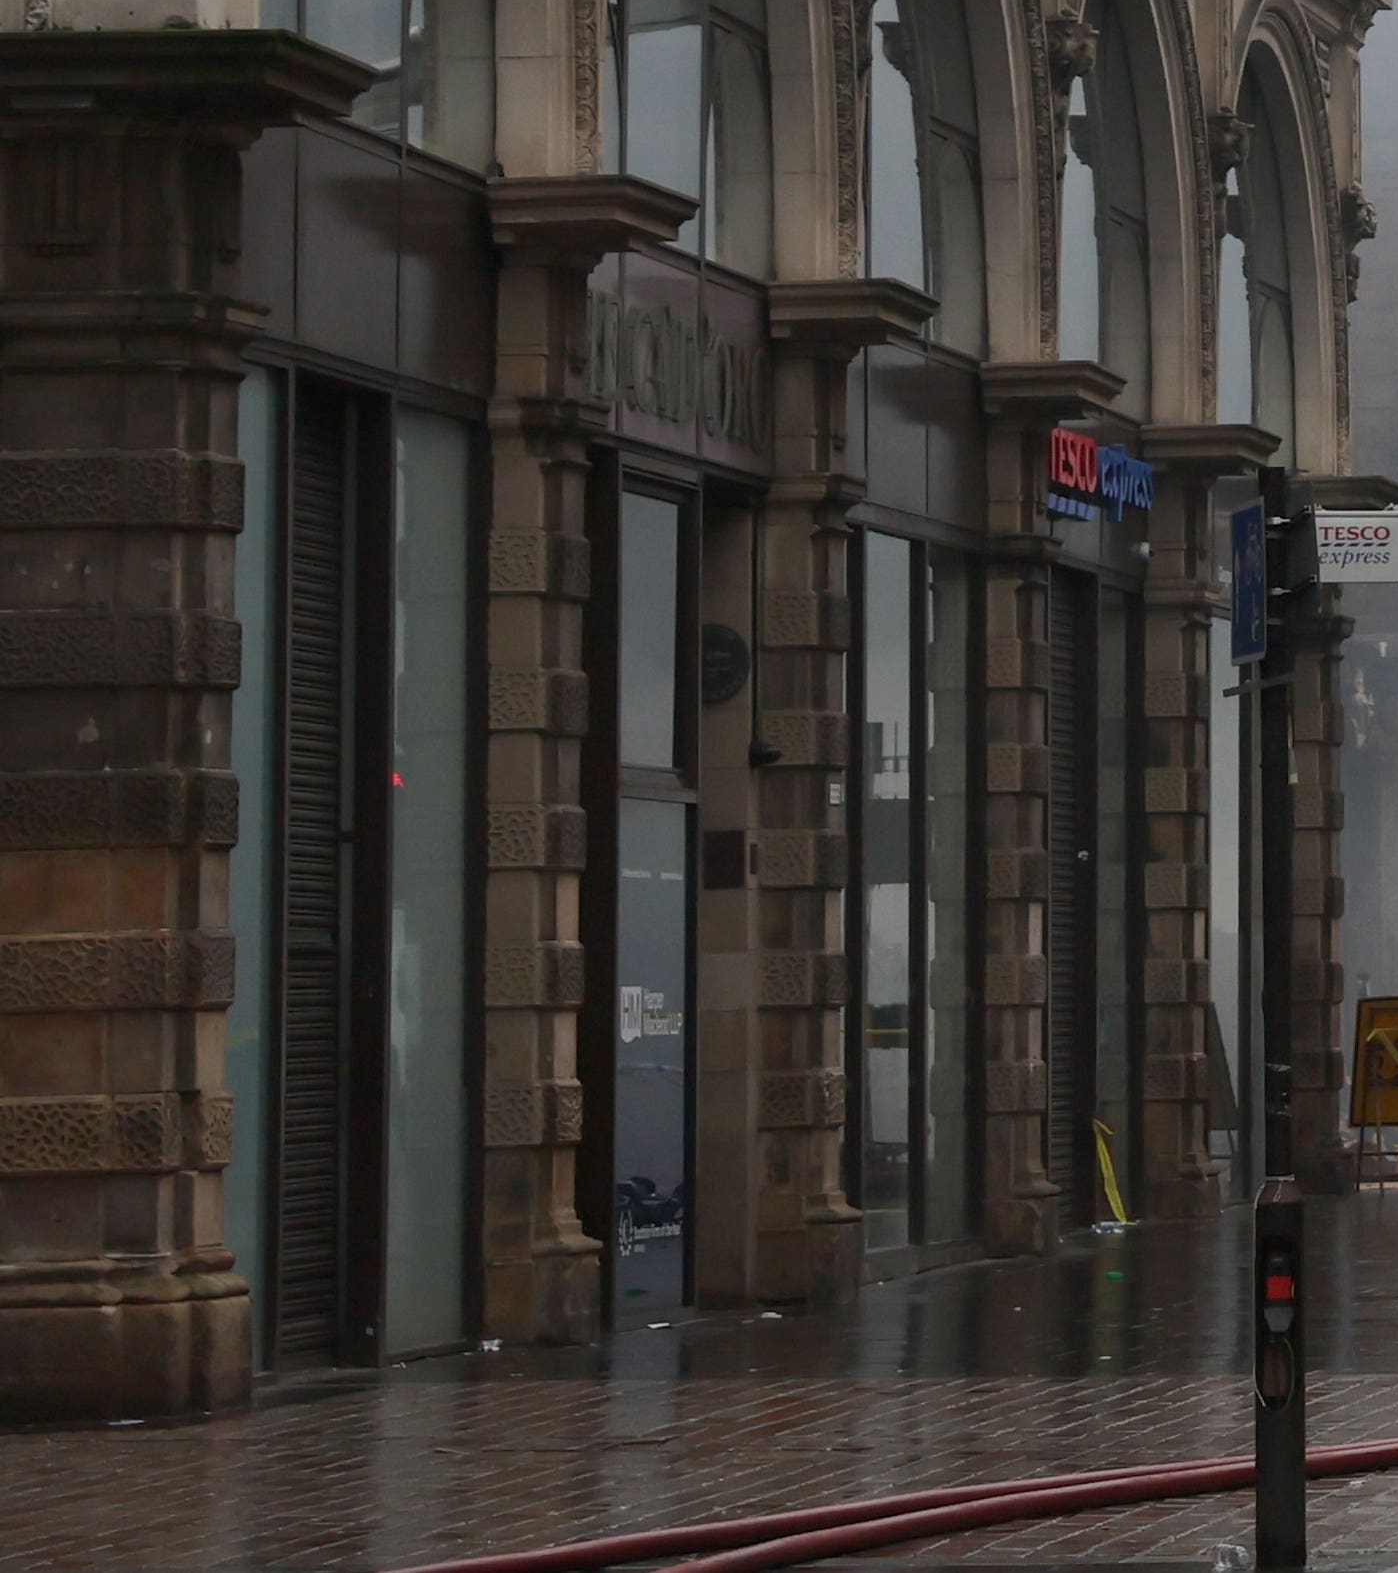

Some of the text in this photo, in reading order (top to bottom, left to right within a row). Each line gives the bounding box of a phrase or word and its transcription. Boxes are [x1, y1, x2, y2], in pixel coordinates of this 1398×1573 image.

[1050, 428, 1153, 523] TESCO express
[1319, 526, 1391, 541] TESCO
[1317, 550, 1391, 569] express
